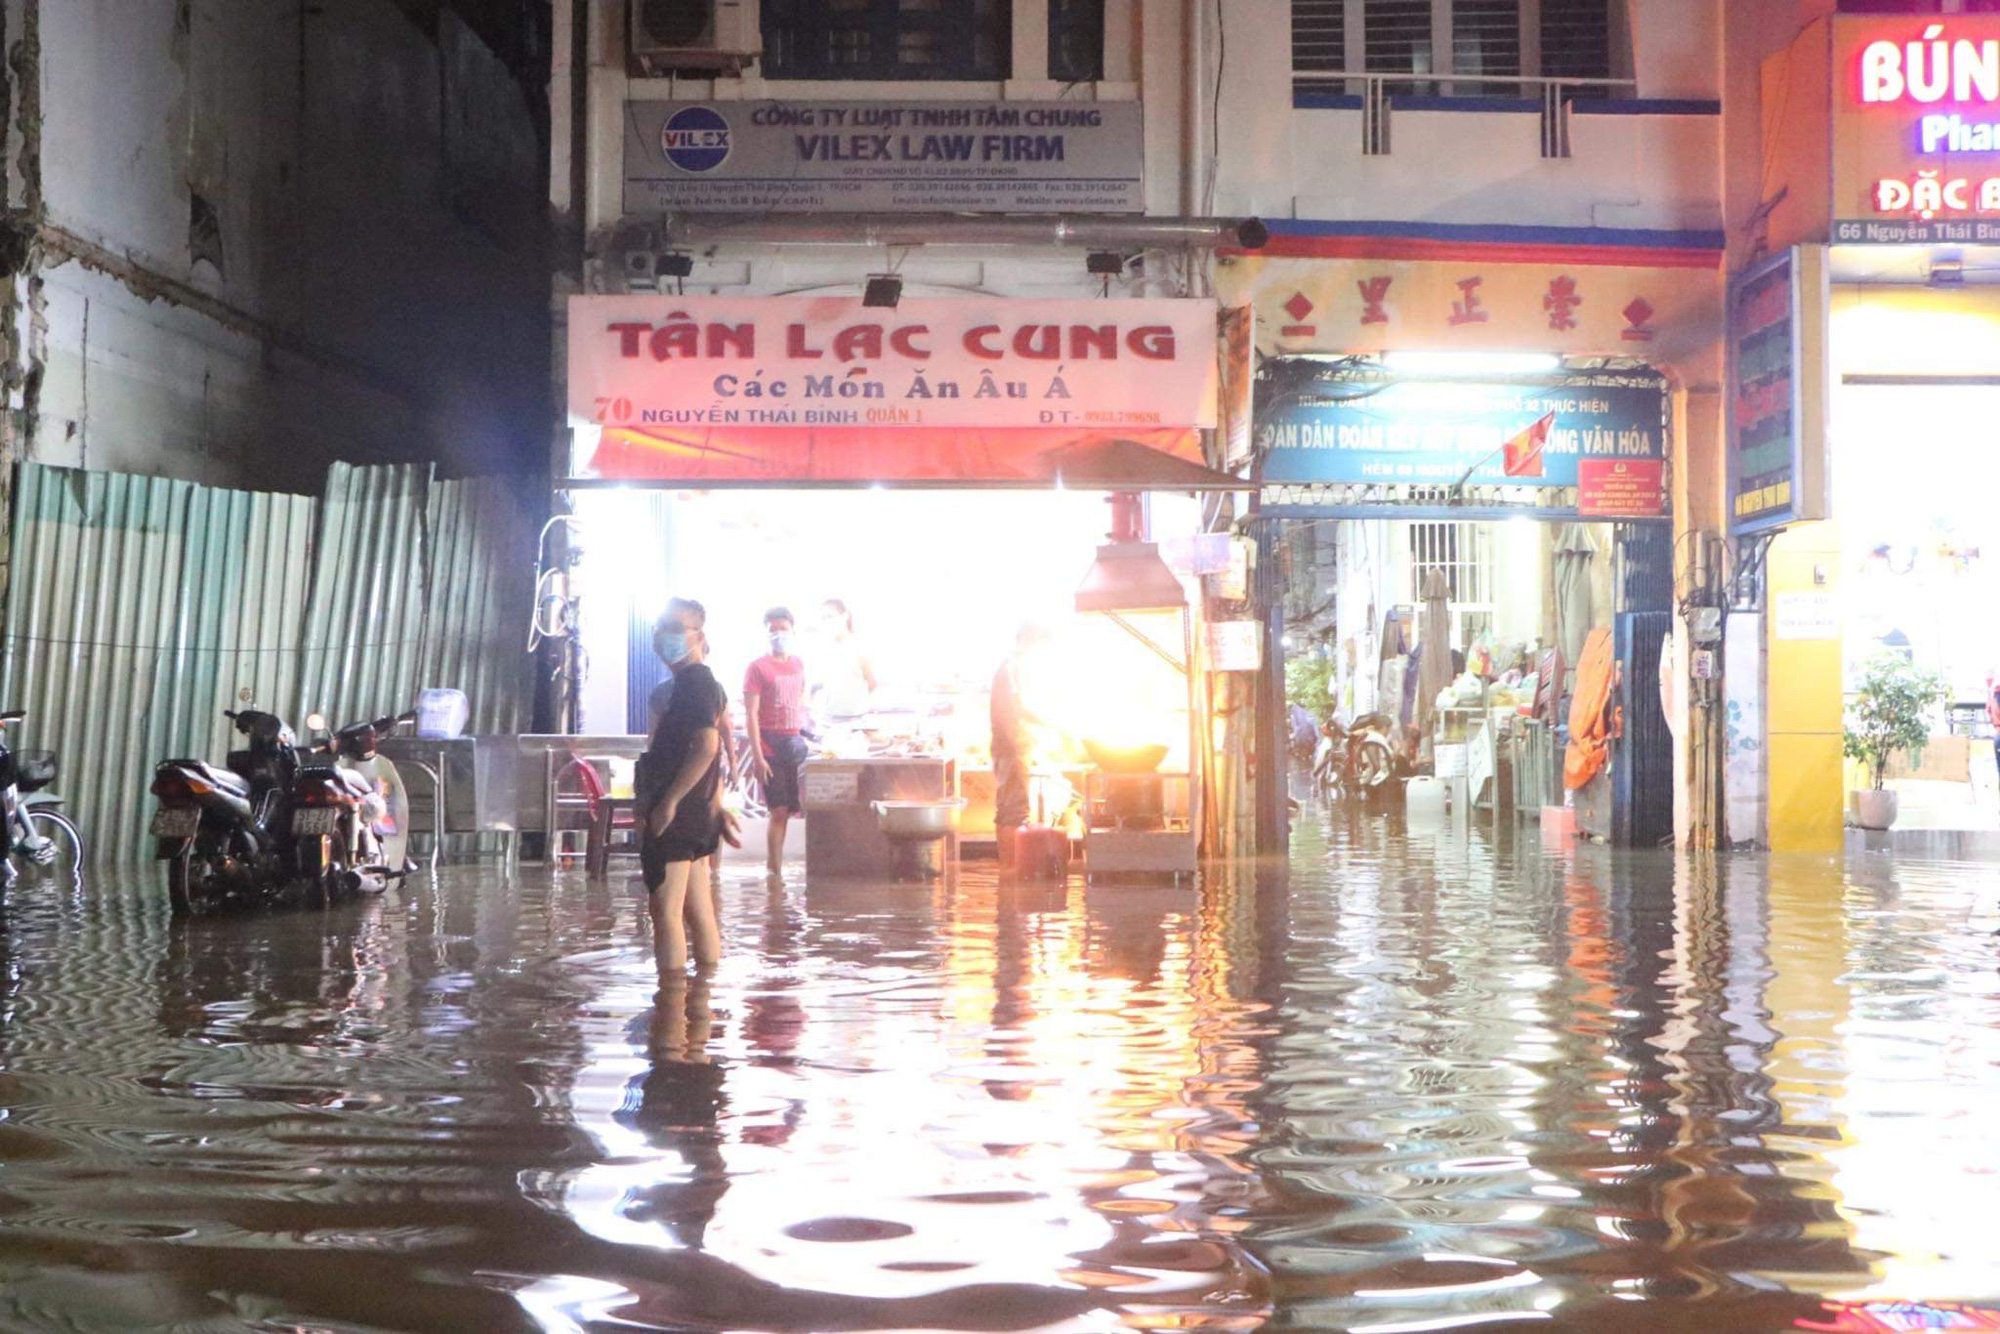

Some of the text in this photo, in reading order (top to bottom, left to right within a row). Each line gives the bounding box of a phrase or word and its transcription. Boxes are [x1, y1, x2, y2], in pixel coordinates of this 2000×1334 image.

[1862, 24, 2000, 103] BÚN
[751, 105, 815, 127] CÔNG
[822, 108, 848, 127] TY
[908, 108, 970, 127] TNHH
[973, 105, 1020, 127] TÂM
[1024, 108, 1102, 127] CHUNG
[664, 131, 730, 148] VILEX
[795, 134, 1066, 162] VILEX LAW FIRM
[1877, 169, 1969, 219] ĐẶC
[1839, 223, 1861, 240] 66
[1866, 221, 1928, 242] Nguyễn
[1933, 222, 1972, 240] Thái
[606, 311, 1176, 375] TÂN LẠC CUNG
[712, 365, 1072, 398] Các Món Ăn Âu Á
[594, 396, 633, 421] 70
[641, 400, 740, 423] NGUYỄN
[746, 403, 797, 423] THÁI
[804, 404, 859, 423] BÌNH
[1542, 398, 1576, 414] THỰC
[1578, 398, 1610, 415] HIỆN
[1301, 418, 1335, 450] DÂN
[1582, 424, 1614, 454] VĂN
[1618, 423, 1651, 454] HÓA
